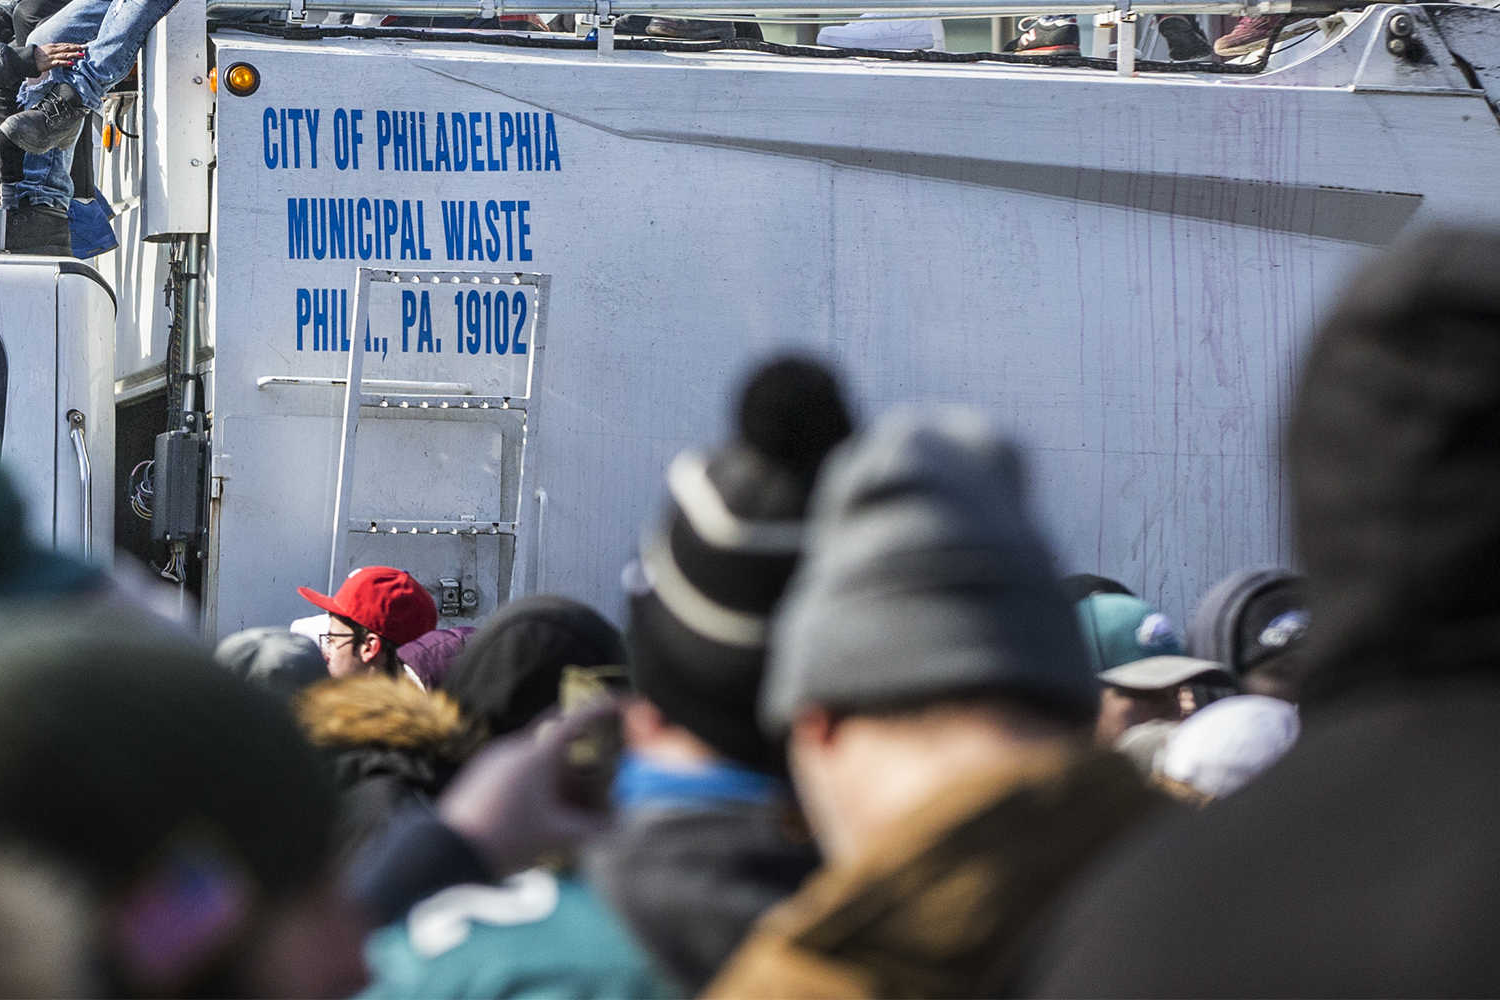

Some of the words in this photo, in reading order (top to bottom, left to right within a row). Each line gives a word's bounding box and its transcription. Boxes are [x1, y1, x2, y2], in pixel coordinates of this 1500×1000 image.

[262, 106, 320, 170] CITY
[333, 107, 364, 171] OF
[376, 109, 562, 172] PHILADELPHIA
[287, 196, 432, 261] MUNICIPAL
[441, 199, 533, 263] WASTE
[401, 289, 442, 354] PA.
[454, 289, 528, 356] 19102
